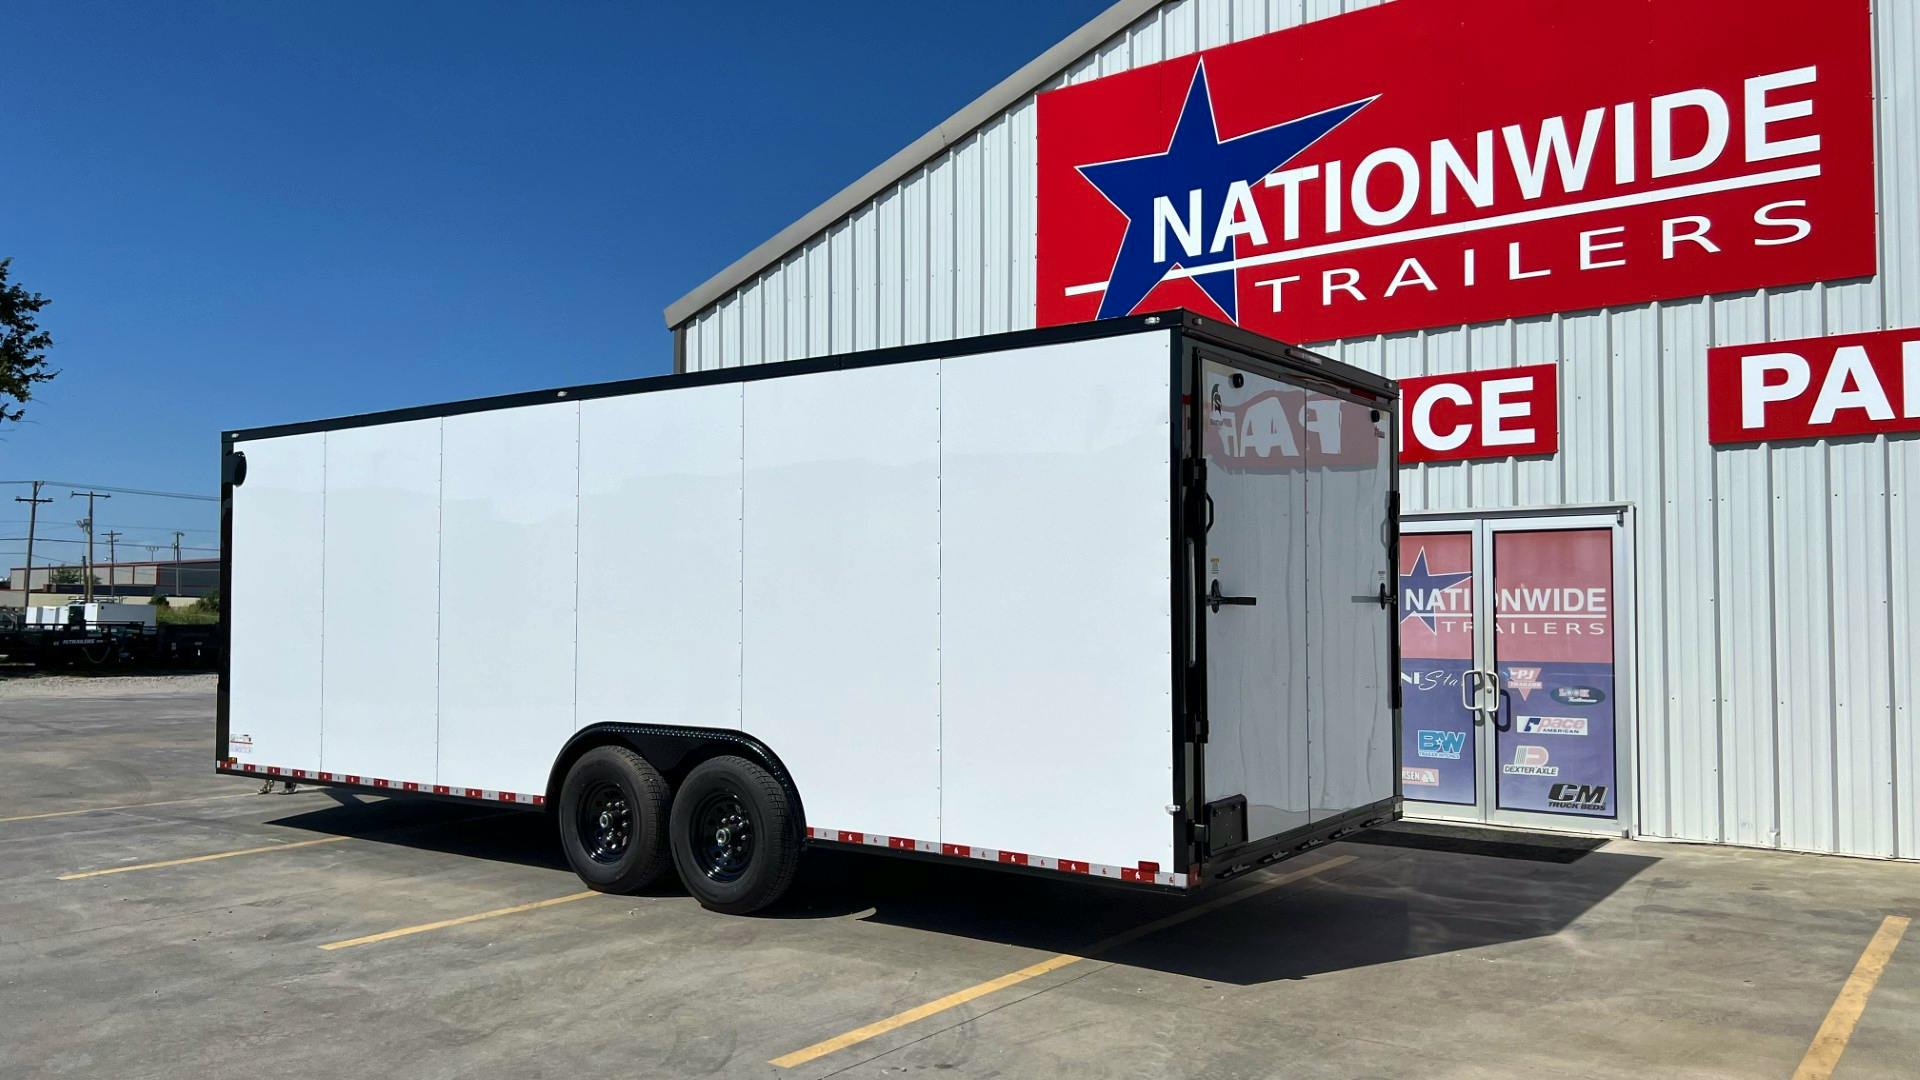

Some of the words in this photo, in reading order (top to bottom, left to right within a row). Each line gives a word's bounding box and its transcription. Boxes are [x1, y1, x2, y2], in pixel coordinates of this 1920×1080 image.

[1154, 65, 1821, 263] NATIONWIDE
[1254, 199, 1812, 313] TRAILERS
[1399, 376, 1536, 453] CE
[1405, 588, 1607, 612] NATINWIDE
[1504, 765, 1535, 774] DEXTER
[1536, 767, 1557, 775] AXLE
